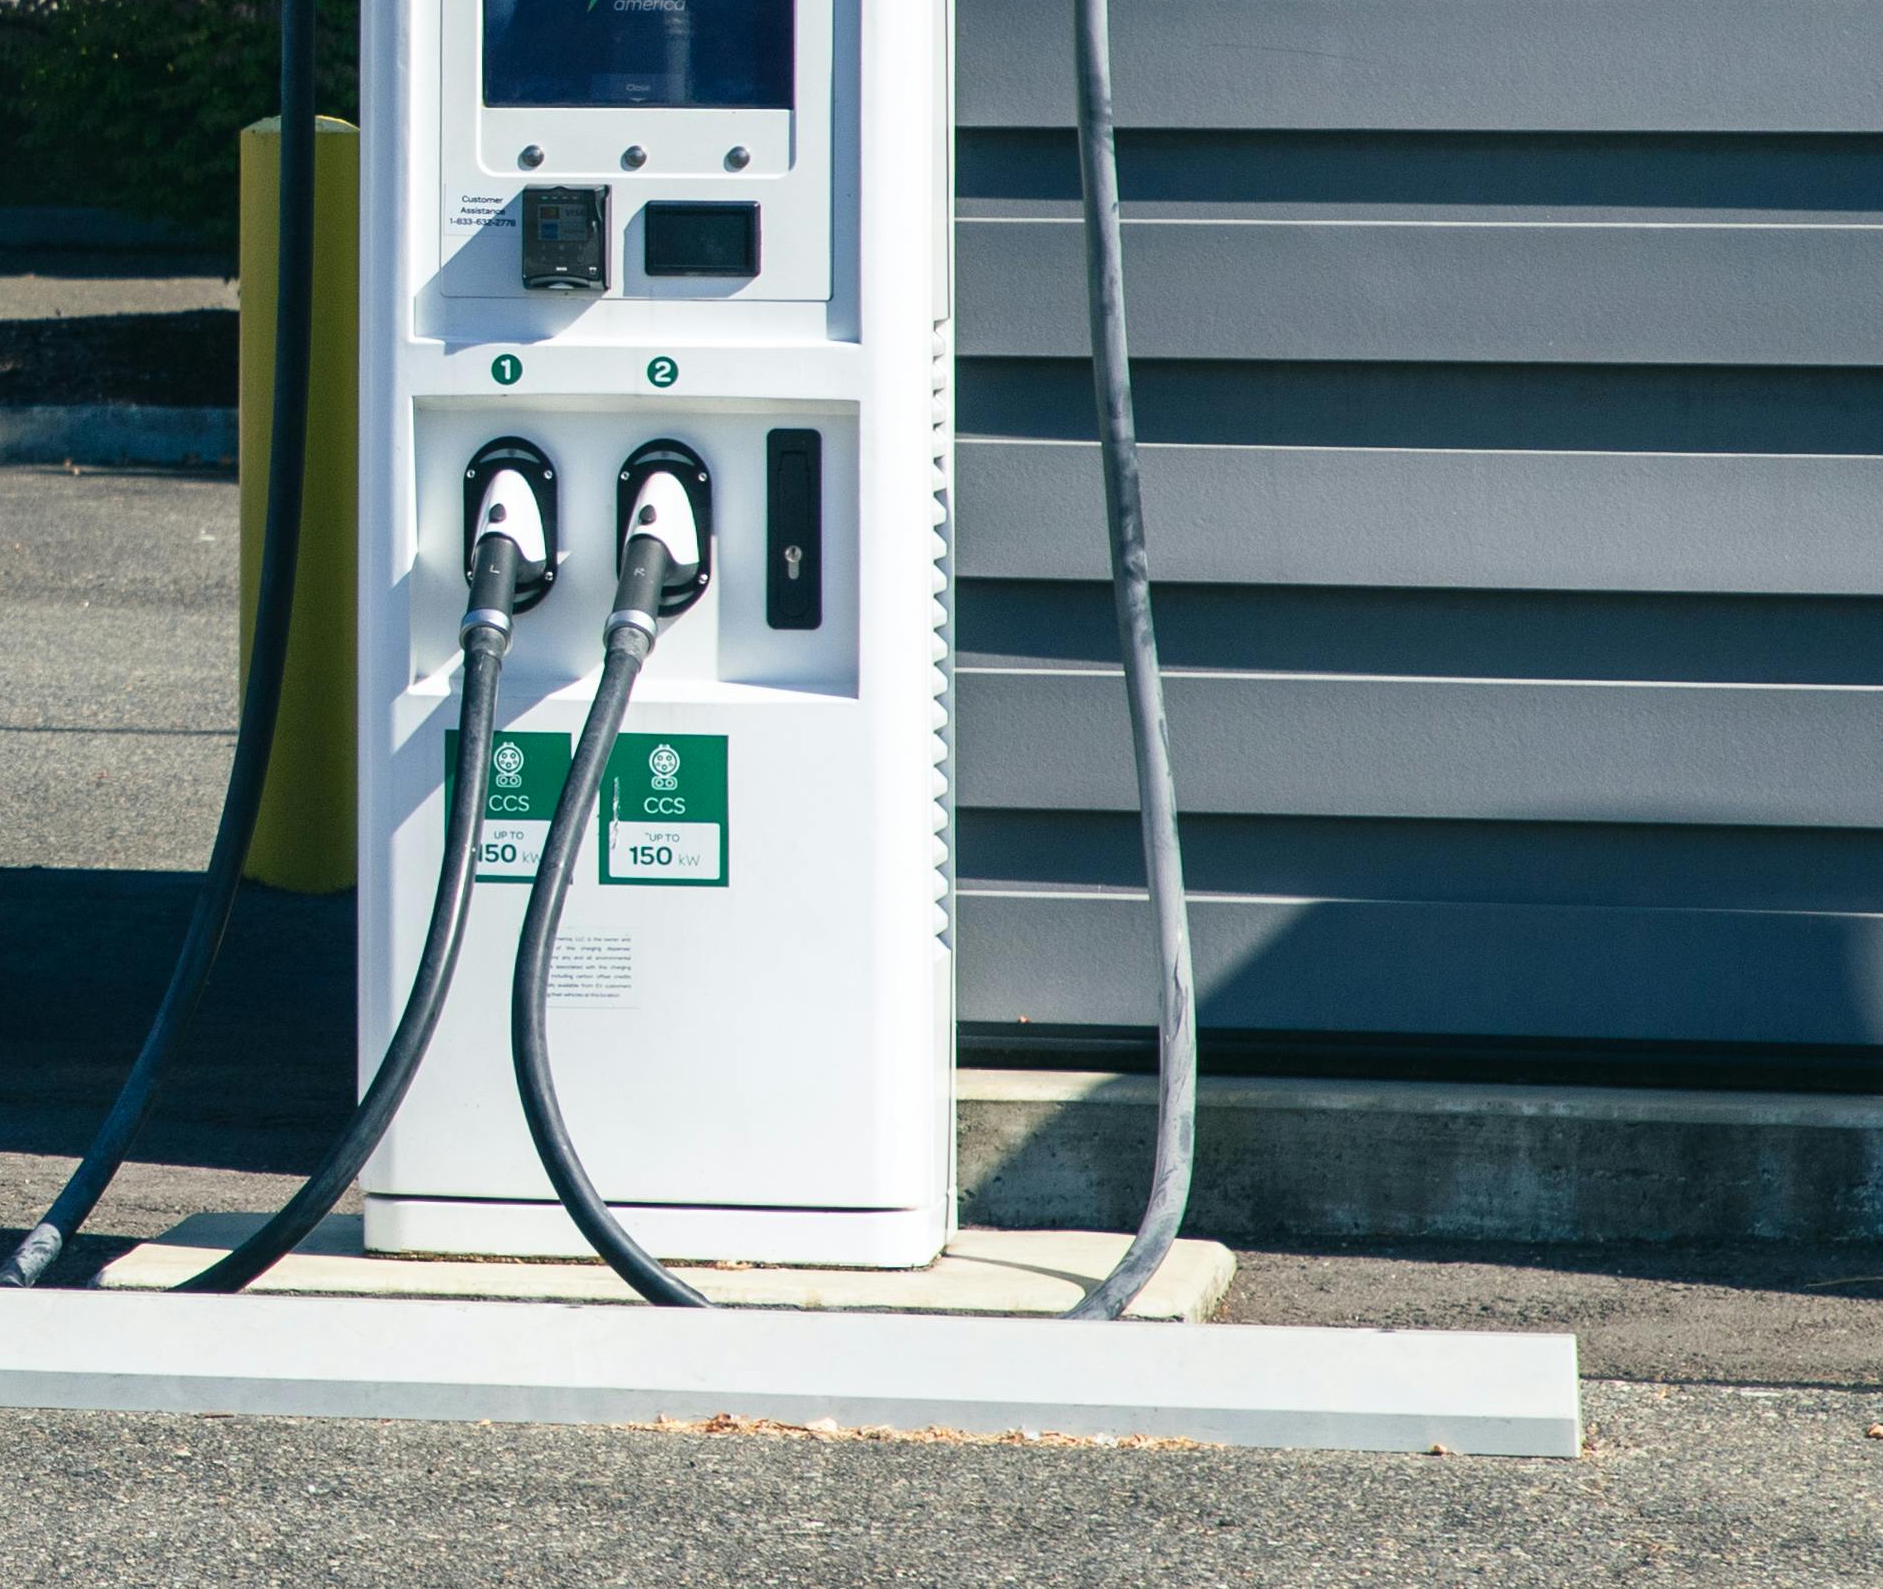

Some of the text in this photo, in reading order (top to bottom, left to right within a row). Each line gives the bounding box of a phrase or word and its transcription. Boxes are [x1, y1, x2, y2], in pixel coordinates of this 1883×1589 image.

[461, 195, 503, 204] Customer
[461, 207, 505, 215] Assistance
[500, 359, 511, 380] 1
[654, 361, 671, 383] 2
[488, 795, 530, 812] CCS
[643, 797, 686, 815] CCS
[493, 831, 524, 840] UP TO
[649, 833, 681, 843] UP TO
[629, 845, 701, 867] 150 kW
